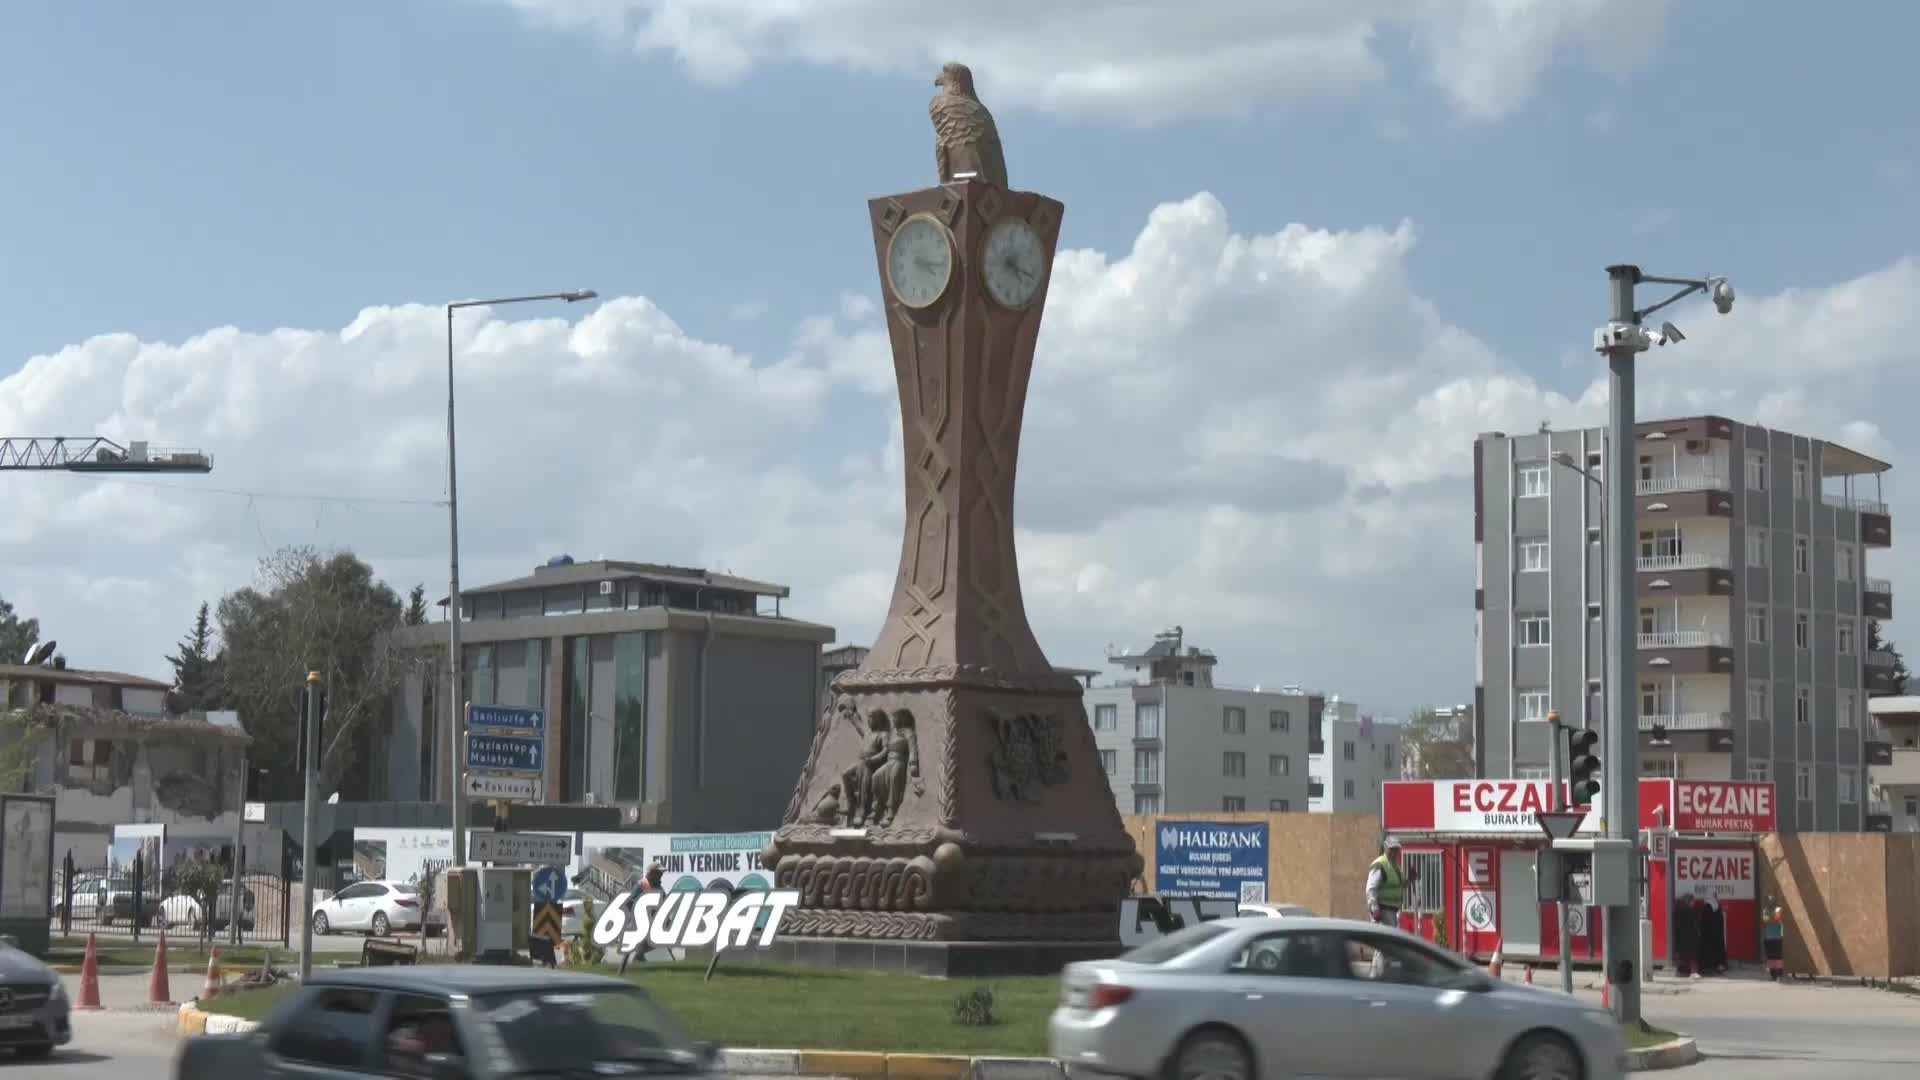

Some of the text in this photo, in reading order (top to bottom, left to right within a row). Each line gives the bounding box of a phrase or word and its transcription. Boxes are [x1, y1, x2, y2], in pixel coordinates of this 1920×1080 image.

[471, 739, 527, 755] Gaziantep
[470, 752, 514, 765] Malatya
[1453, 783, 1592, 813] ECZAN
[1677, 785, 1771, 816] ECZANE
[1484, 813, 1519, 825] BURAK
[1695, 817, 1723, 829] BURAK
[1179, 831, 1262, 848] HALKBANK
[1655, 837, 1664, 852] E
[1677, 856, 1751, 880] ECZANE
